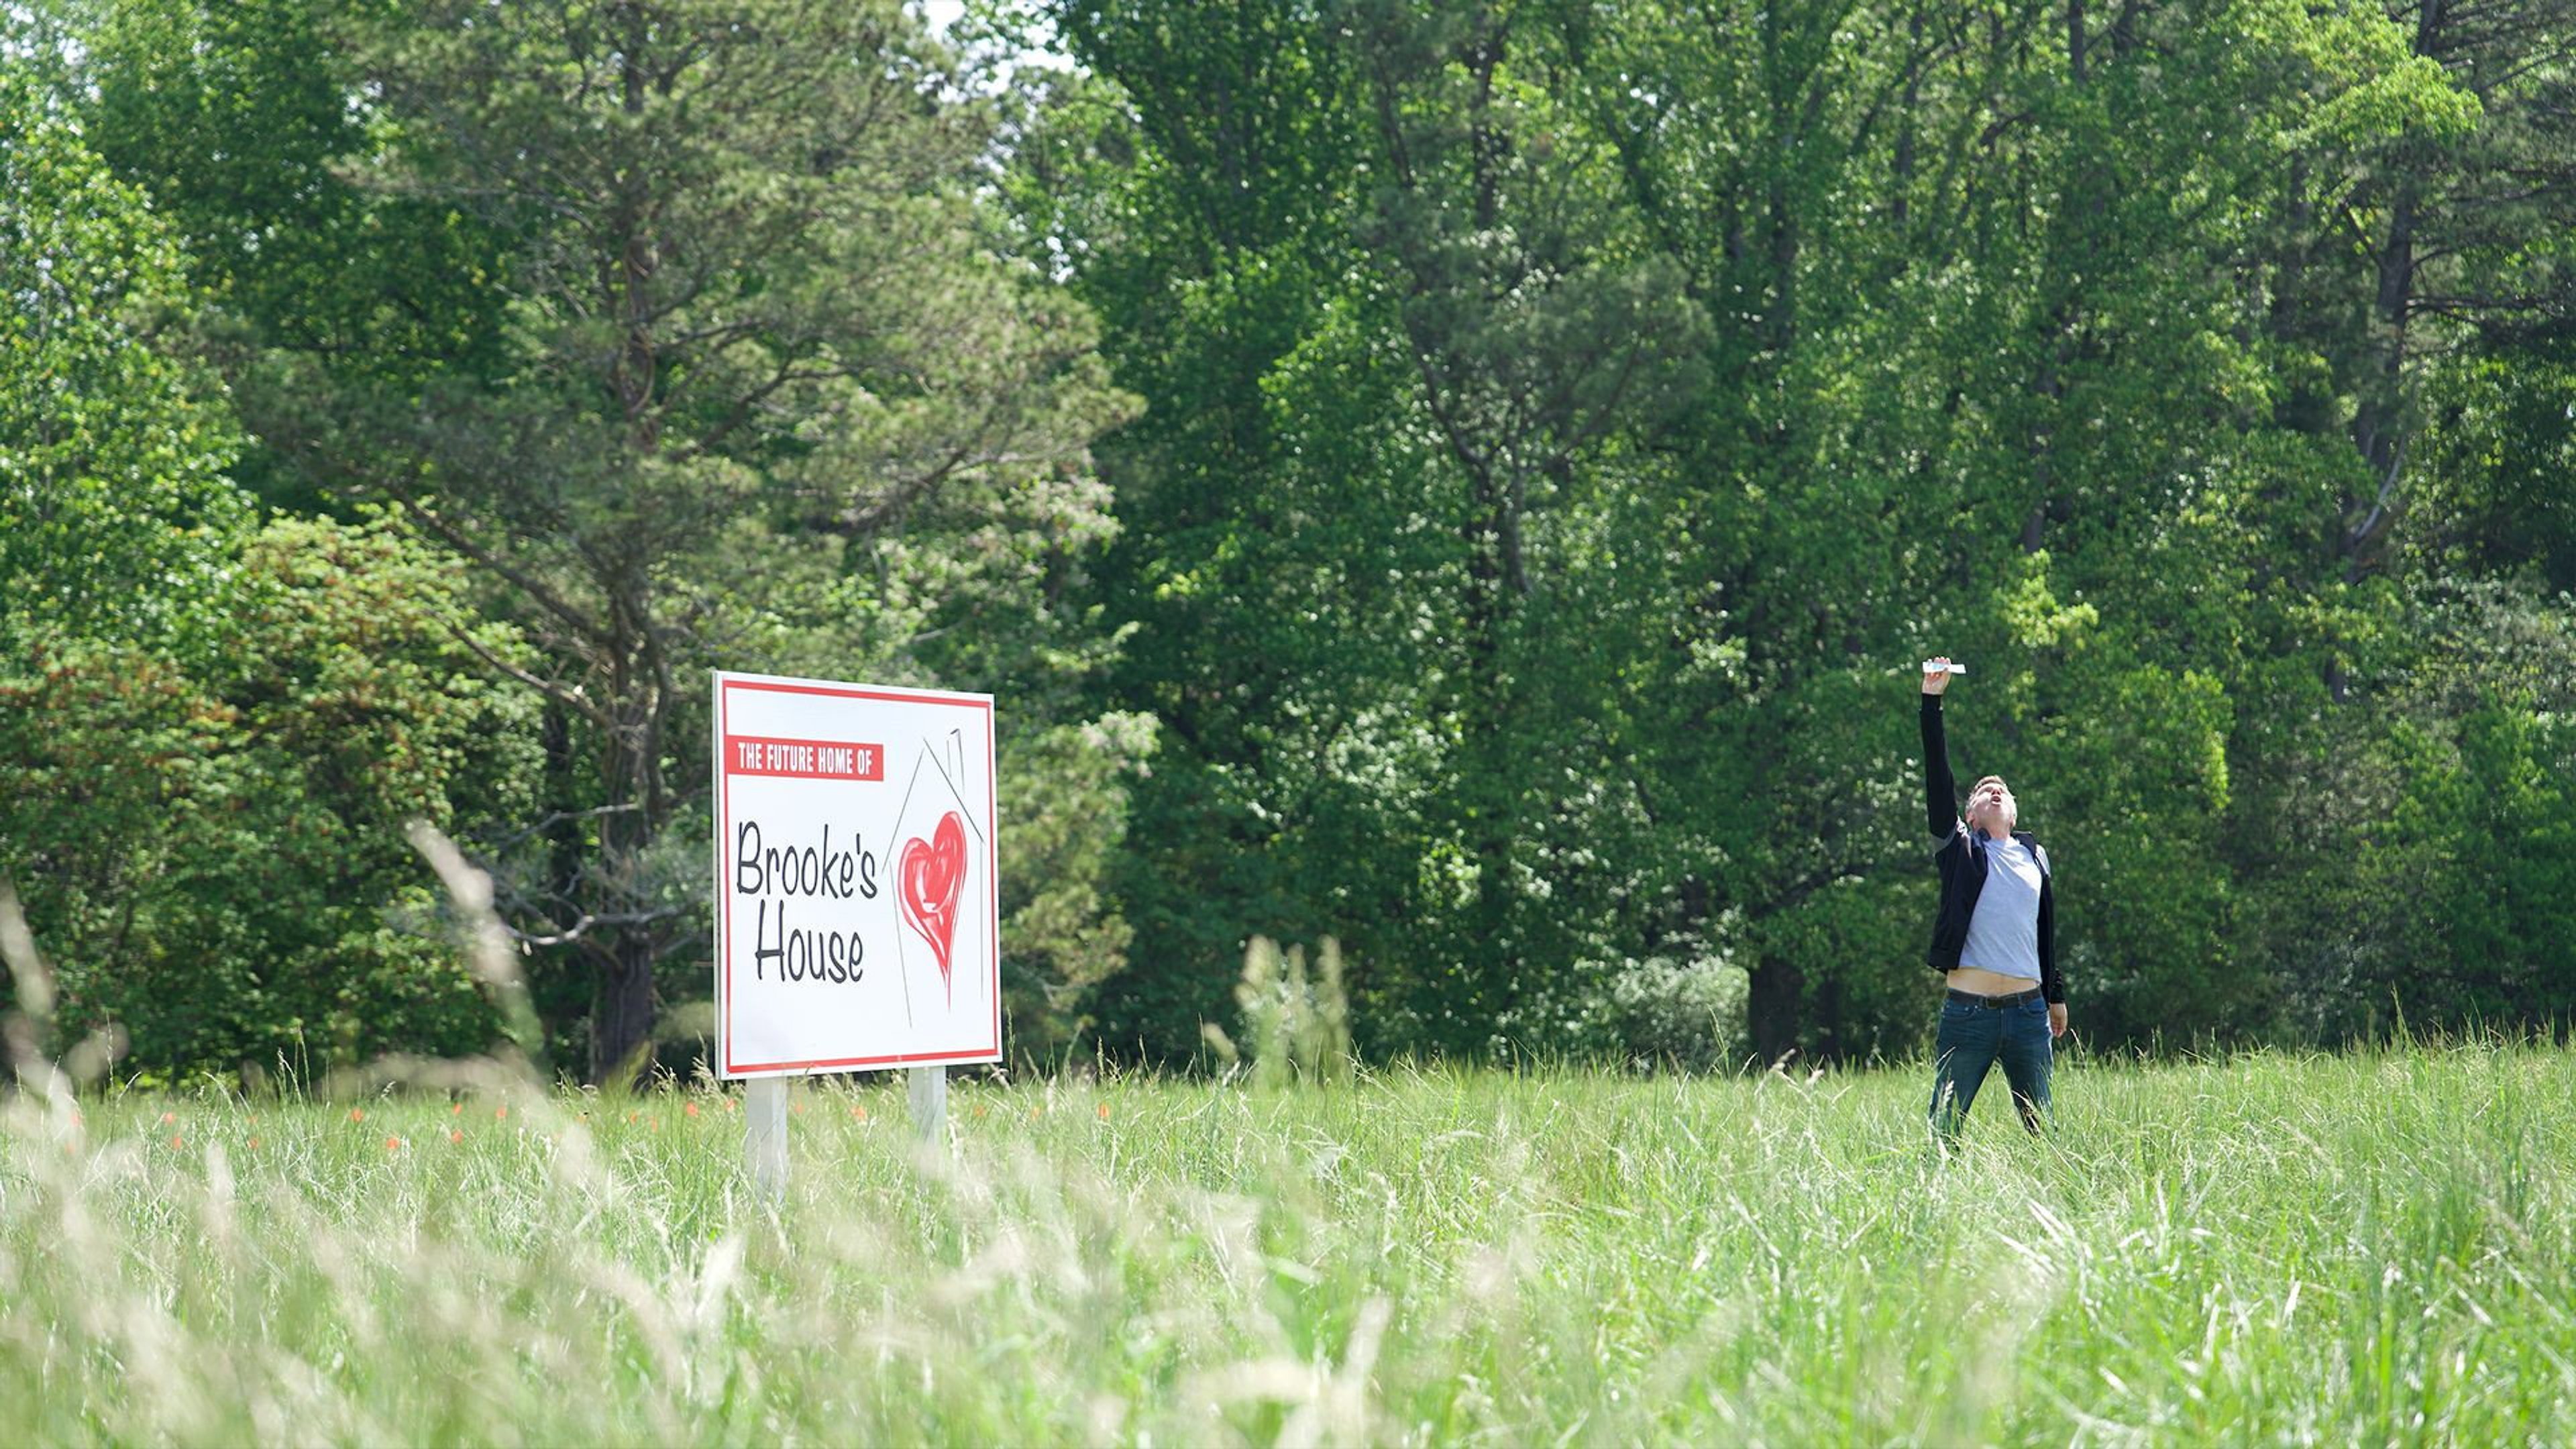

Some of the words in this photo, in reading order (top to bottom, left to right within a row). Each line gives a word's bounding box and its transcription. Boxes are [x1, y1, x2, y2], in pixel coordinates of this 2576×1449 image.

[739, 743, 763, 769] THE
[767, 745, 814, 772] FUTURE
[818, 747, 853, 774] HOME
[857, 749, 872, 775] OF
[737, 821, 877, 899] Brooke's
[755, 900, 863, 983] House
